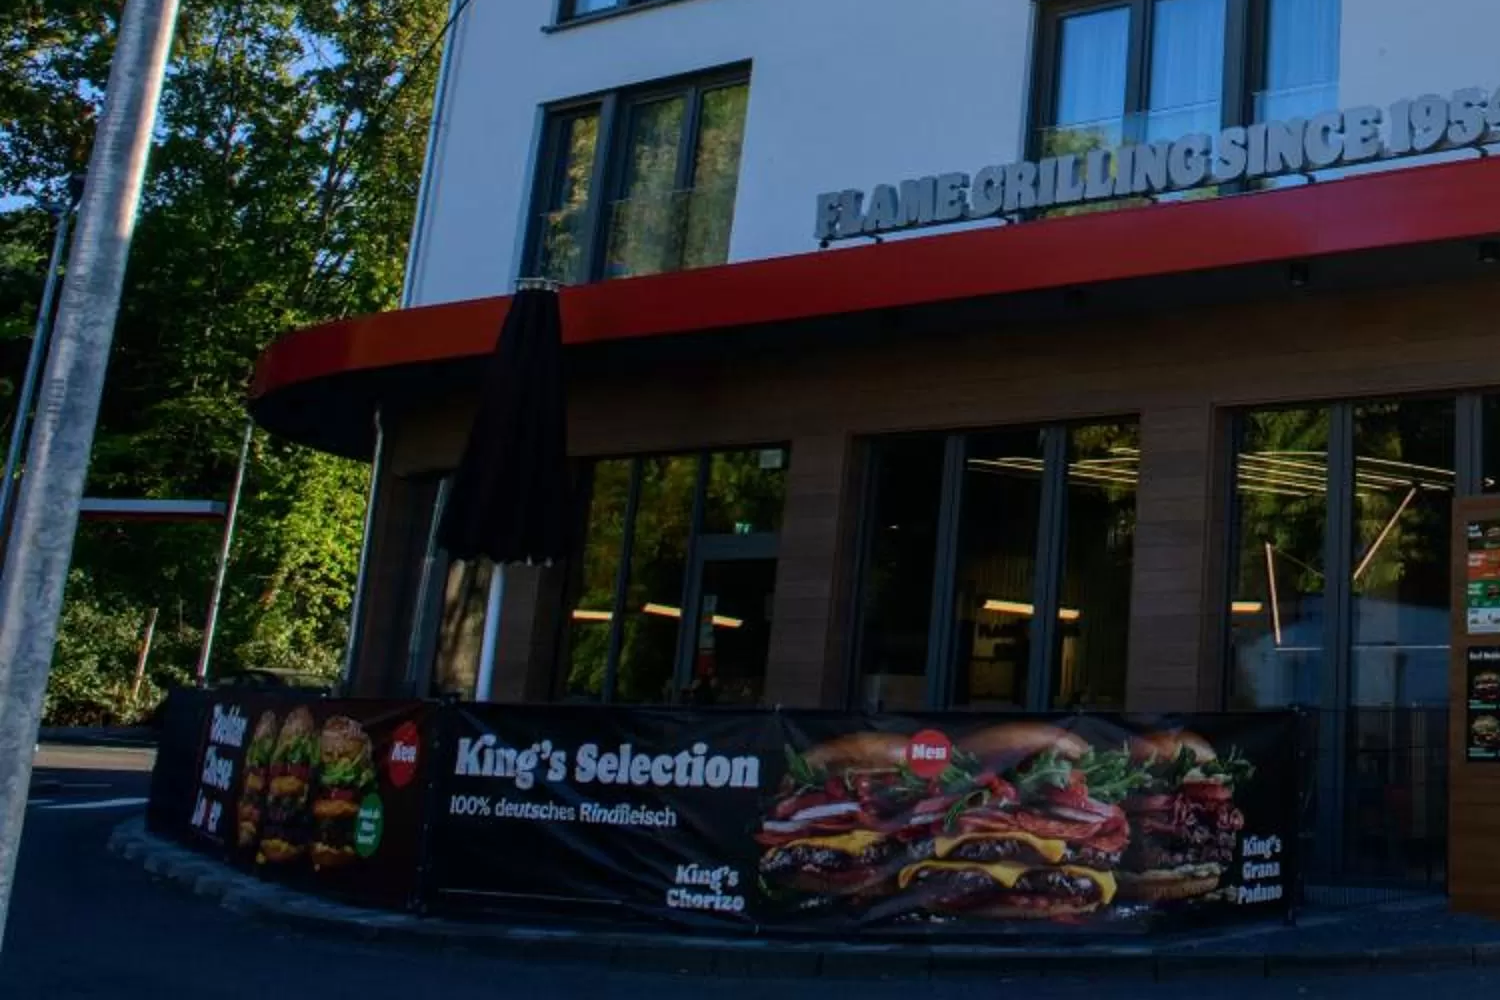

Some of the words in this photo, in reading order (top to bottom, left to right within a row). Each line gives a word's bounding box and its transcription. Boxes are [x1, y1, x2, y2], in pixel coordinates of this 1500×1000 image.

[814, 171, 971, 240] FLAME
[970, 133, 1212, 217] GRILLING
[1212, 104, 1384, 181] SINCE
[455, 734, 568, 790] King's
[574, 742, 760, 788] Selection
[911, 743, 947, 761] Neu
[449, 794, 491, 817] 100%
[494, 797, 576, 822] deutsches
[579, 802, 678, 828] Rindfleisch
[675, 863, 740, 892] King's
[1242, 861, 1281, 880] Grana
[665, 888, 745, 913] Chorizo
[1237, 883, 1284, 905] Padano
